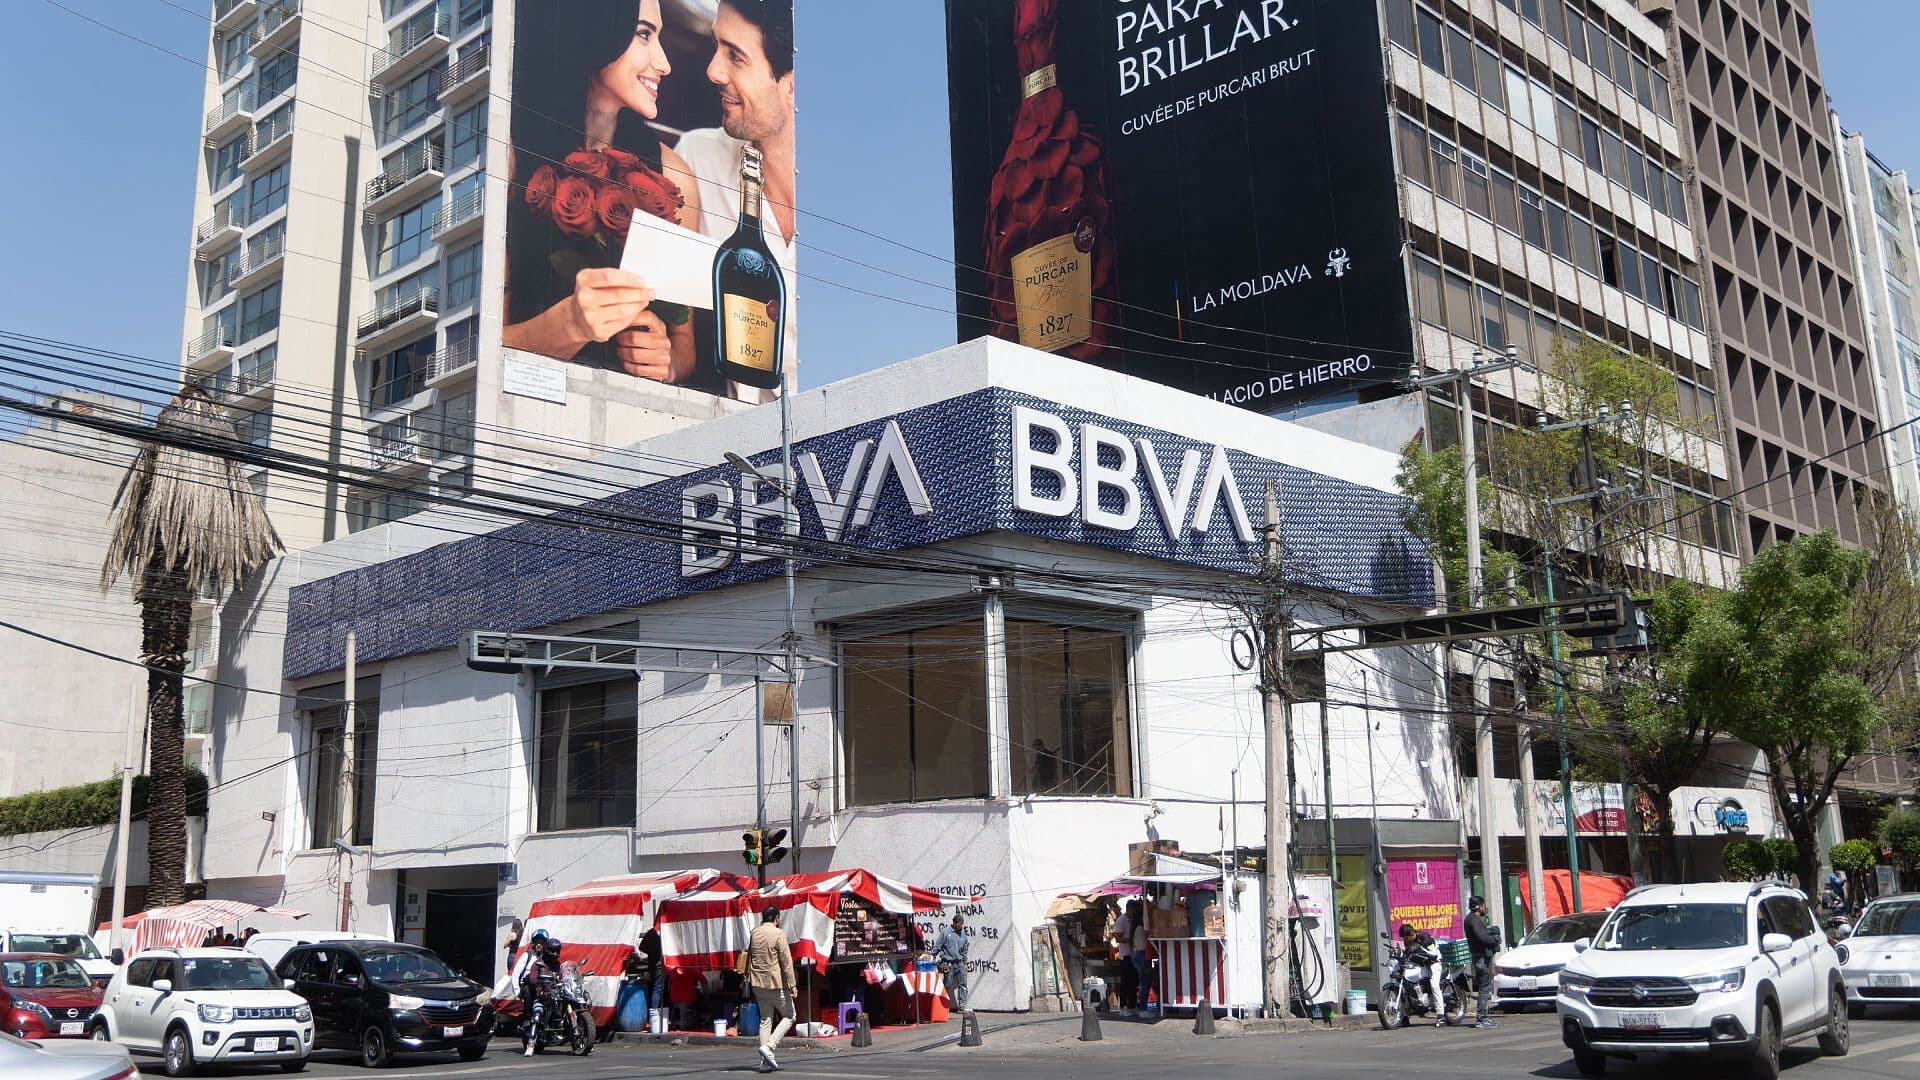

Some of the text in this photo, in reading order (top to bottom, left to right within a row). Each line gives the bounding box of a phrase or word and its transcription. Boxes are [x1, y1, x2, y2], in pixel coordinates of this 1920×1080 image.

[1115, 0, 1225, 51] PARA
[1117, 0, 1299, 96] BRILLAR.
[1121, 49, 1315, 135] CUVÉE DE PURCARI BRUT
[1025, 260, 1079, 288] PURCARI
[1193, 263, 1313, 313] LA MOLDAVA
[732, 312, 769, 328] PURCARI
[1039, 313, 1073, 337] 1827
[740, 344, 764, 361] 1827
[1205, 354, 1376, 404] ACIO DE HIERRO.
[1011, 405, 1256, 543] BBVA
[681, 420, 933, 577] BBVA
[969, 883, 986, 897] LOS
[955, 903, 985, 917] AHORA
[1390, 903, 1458, 921] ¿QUIERES MEJORES
[981, 926, 999, 940] SER
